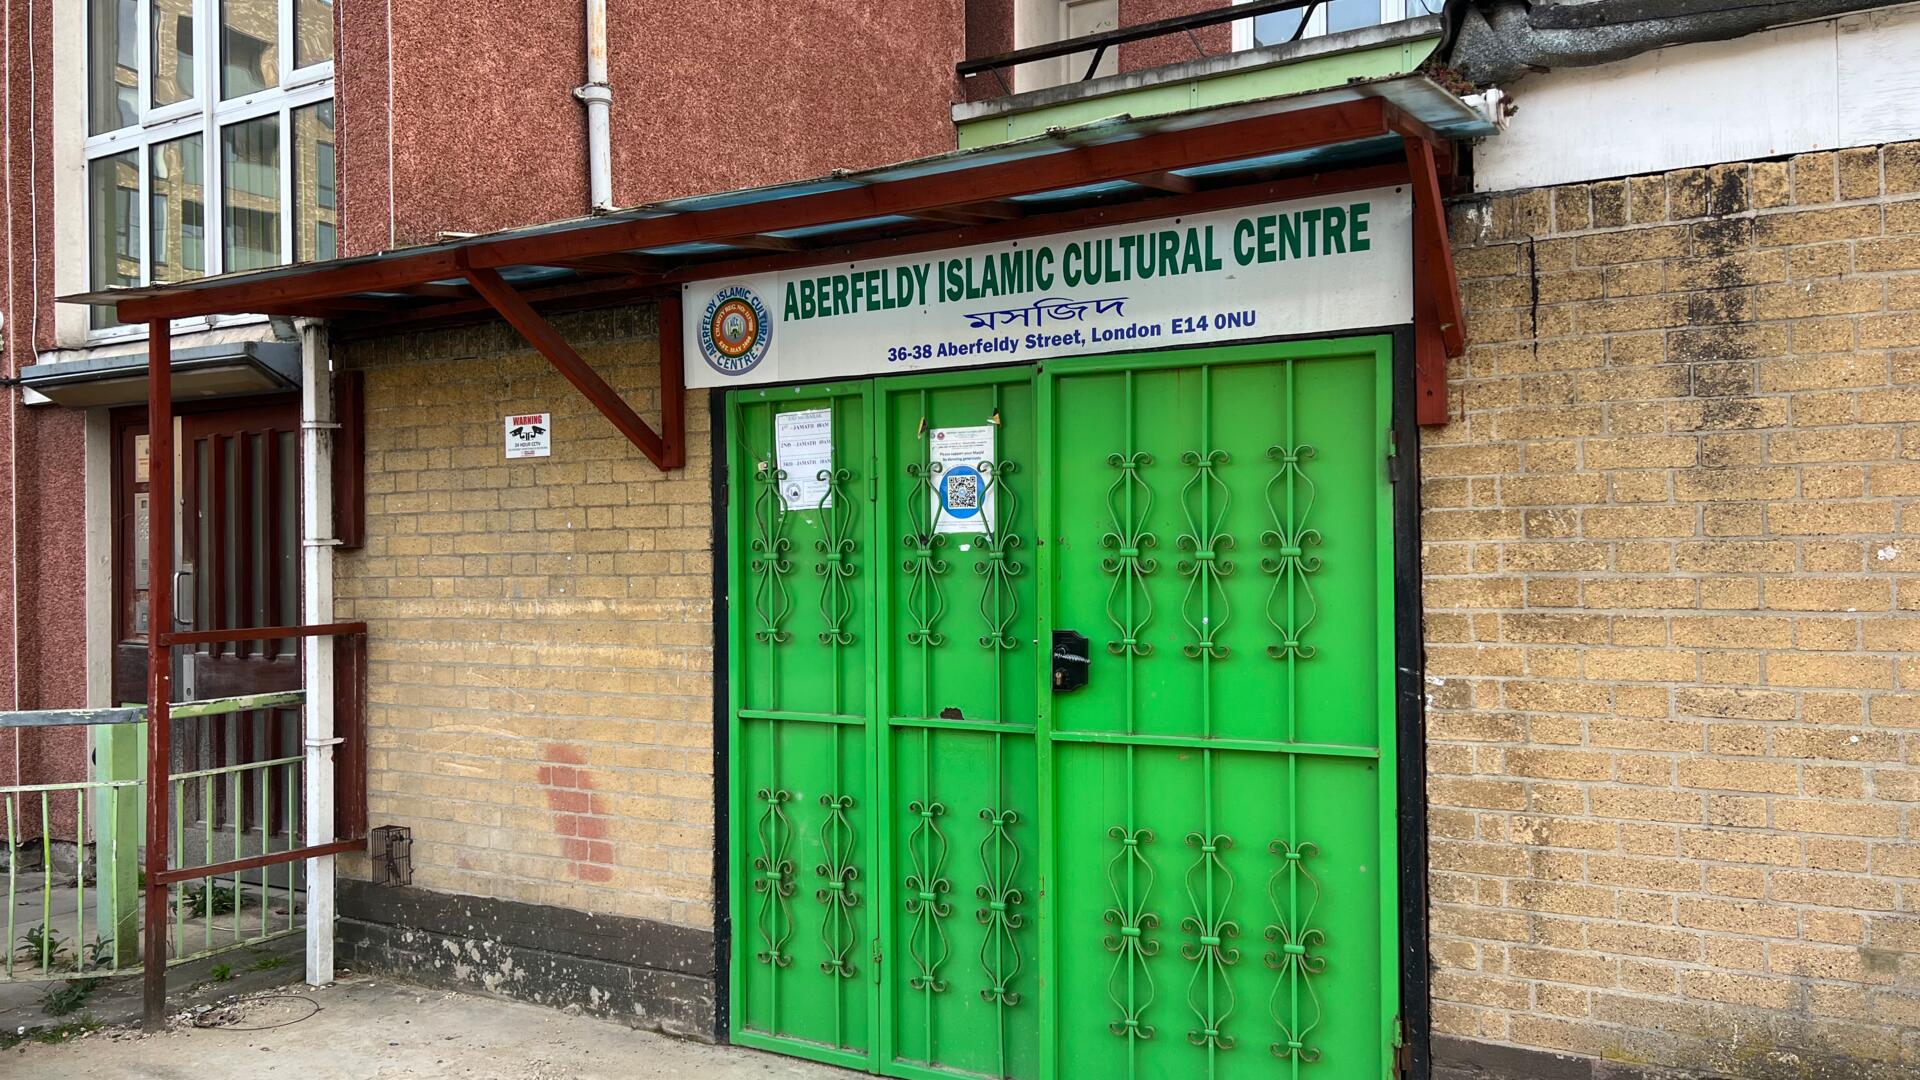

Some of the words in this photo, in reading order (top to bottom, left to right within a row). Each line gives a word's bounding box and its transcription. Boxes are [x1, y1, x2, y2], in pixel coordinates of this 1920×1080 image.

[784, 263, 931, 322] ABERFELDY
[938, 246, 1055, 303] ISLAMIC
[1063, 225, 1223, 288] CULTURAL
[1233, 202, 1371, 266] CENTRE
[702, 299, 717, 357] ABERFELDY
[716, 287, 752, 302] ISLAMIC
[751, 296, 769, 348] CULTURAL
[963, 296, 1130, 331] মসজিদ
[888, 344, 933, 362] 36-38
[937, 336, 1019, 358] Aberfeldy
[1025, 329, 1086, 350] Street,
[1092, 323, 1162, 342] London
[1172, 315, 1209, 334] E14
[716, 349, 758, 370] CENTRE
[512, 415, 543, 426] WARNING
